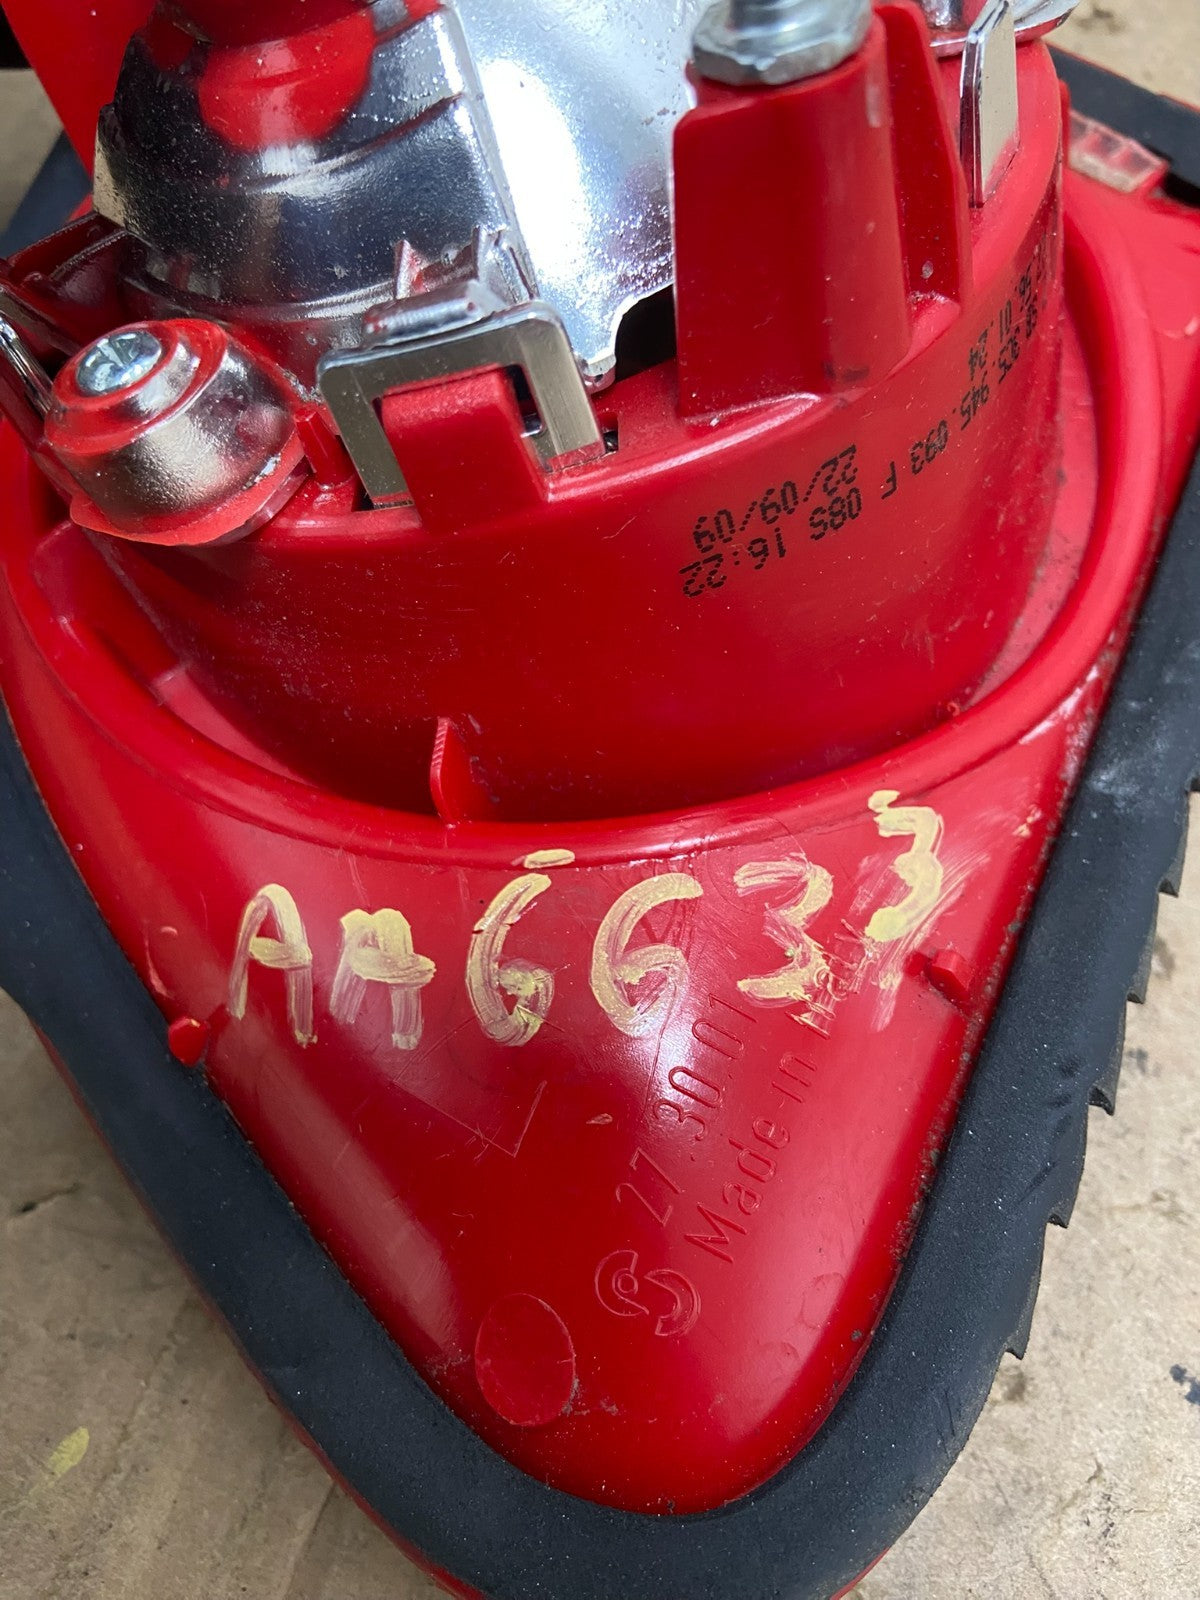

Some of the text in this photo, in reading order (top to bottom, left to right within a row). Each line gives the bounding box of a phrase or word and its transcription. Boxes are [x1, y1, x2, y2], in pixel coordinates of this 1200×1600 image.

[693, 444, 858, 553] 22/09/09
[881, 461, 898, 500] F
[679, 527, 787, 598] 16:22
[684, 1116, 791, 1264] Made
